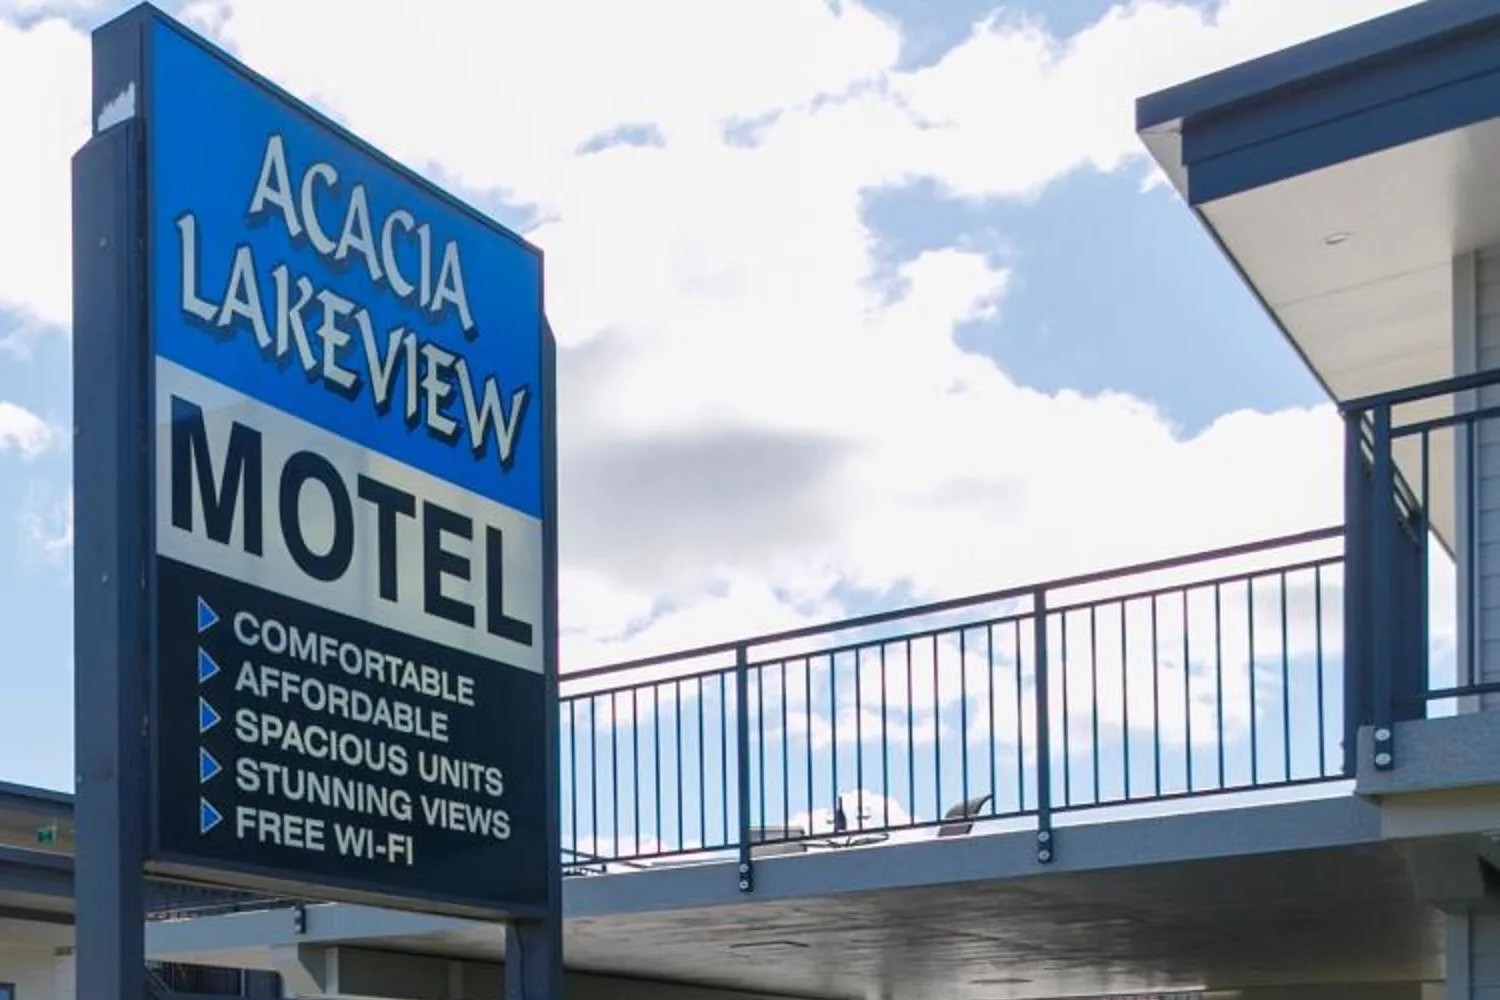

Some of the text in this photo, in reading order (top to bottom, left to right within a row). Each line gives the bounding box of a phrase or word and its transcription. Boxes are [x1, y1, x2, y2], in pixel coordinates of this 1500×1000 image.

[250, 134, 474, 333] ACACIA
[177, 213, 527, 464] LAKEVIEW
[171, 394, 533, 647] MOTEL
[233, 612, 476, 706] COMFORTABLE
[235, 661, 449, 742] AFFORDABLE
[235, 708, 503, 797] SPACIOUS UNITS
[236, 758, 511, 839] STUNNING VIEWS
[236, 806, 413, 866] FREE WI-FI
